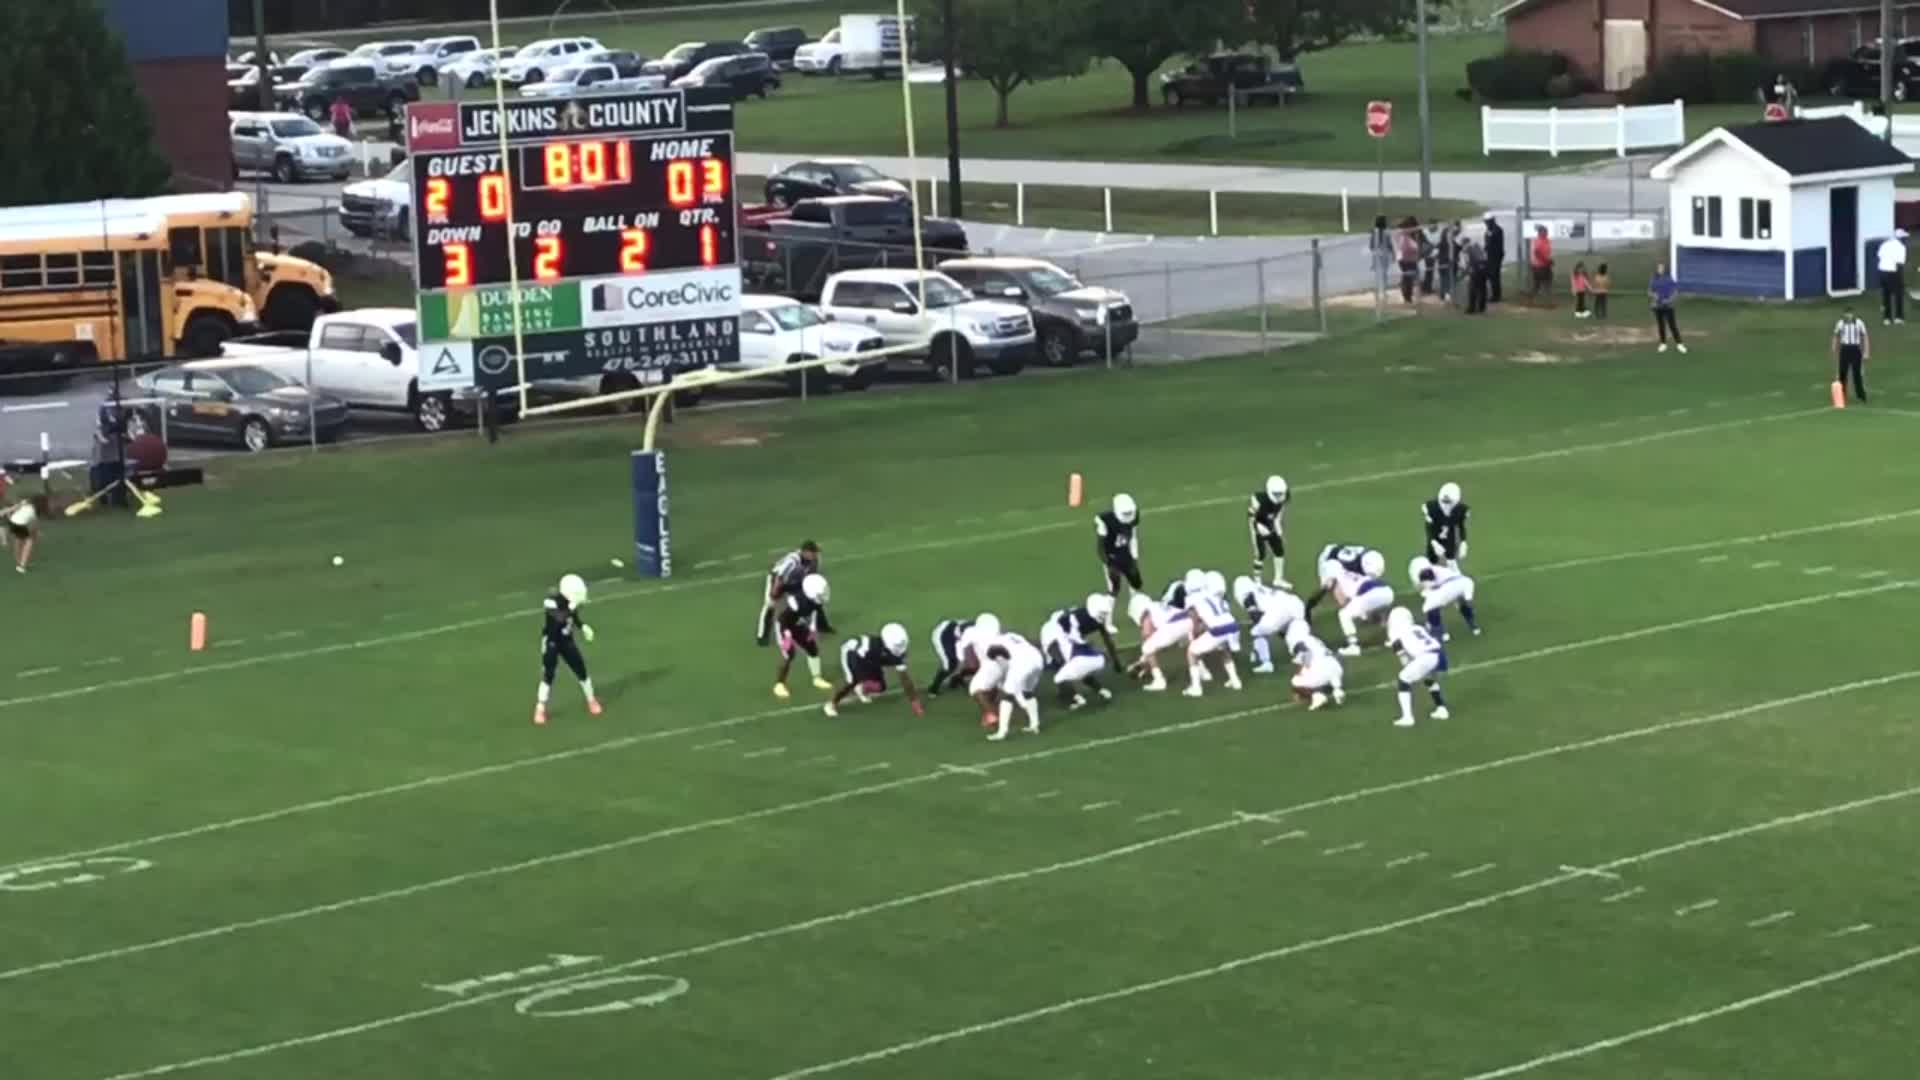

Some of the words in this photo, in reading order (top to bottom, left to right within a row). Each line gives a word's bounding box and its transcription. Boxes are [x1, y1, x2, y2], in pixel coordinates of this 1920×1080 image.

[589, 97, 678, 127] COUNTY
[427, 153, 502, 177] GUEST
[544, 140, 630, 187] 8:01
[650, 138, 715, 161] HOME
[667, 161, 695, 204] 0
[702, 158, 723, 193] 3
[426, 177, 450, 213] 2
[479, 173, 505, 217] 0
[511, 222, 531, 238] TO
[537, 218, 562, 236] GO
[583, 215, 627, 233] BALL
[634, 211, 660, 229] ON
[679, 208, 720, 226] QTR.
[427, 226, 482, 245] DOWN
[619, 228, 647, 275] 2
[700, 224, 716, 268] 1
[443, 244, 471, 287] 3
[533, 236, 562, 282] 2
[627, 280, 732, 309] CoreCivic
[584, 319, 734, 348] SOUTHLAND
[655, 450, 672, 578] EAGLES
